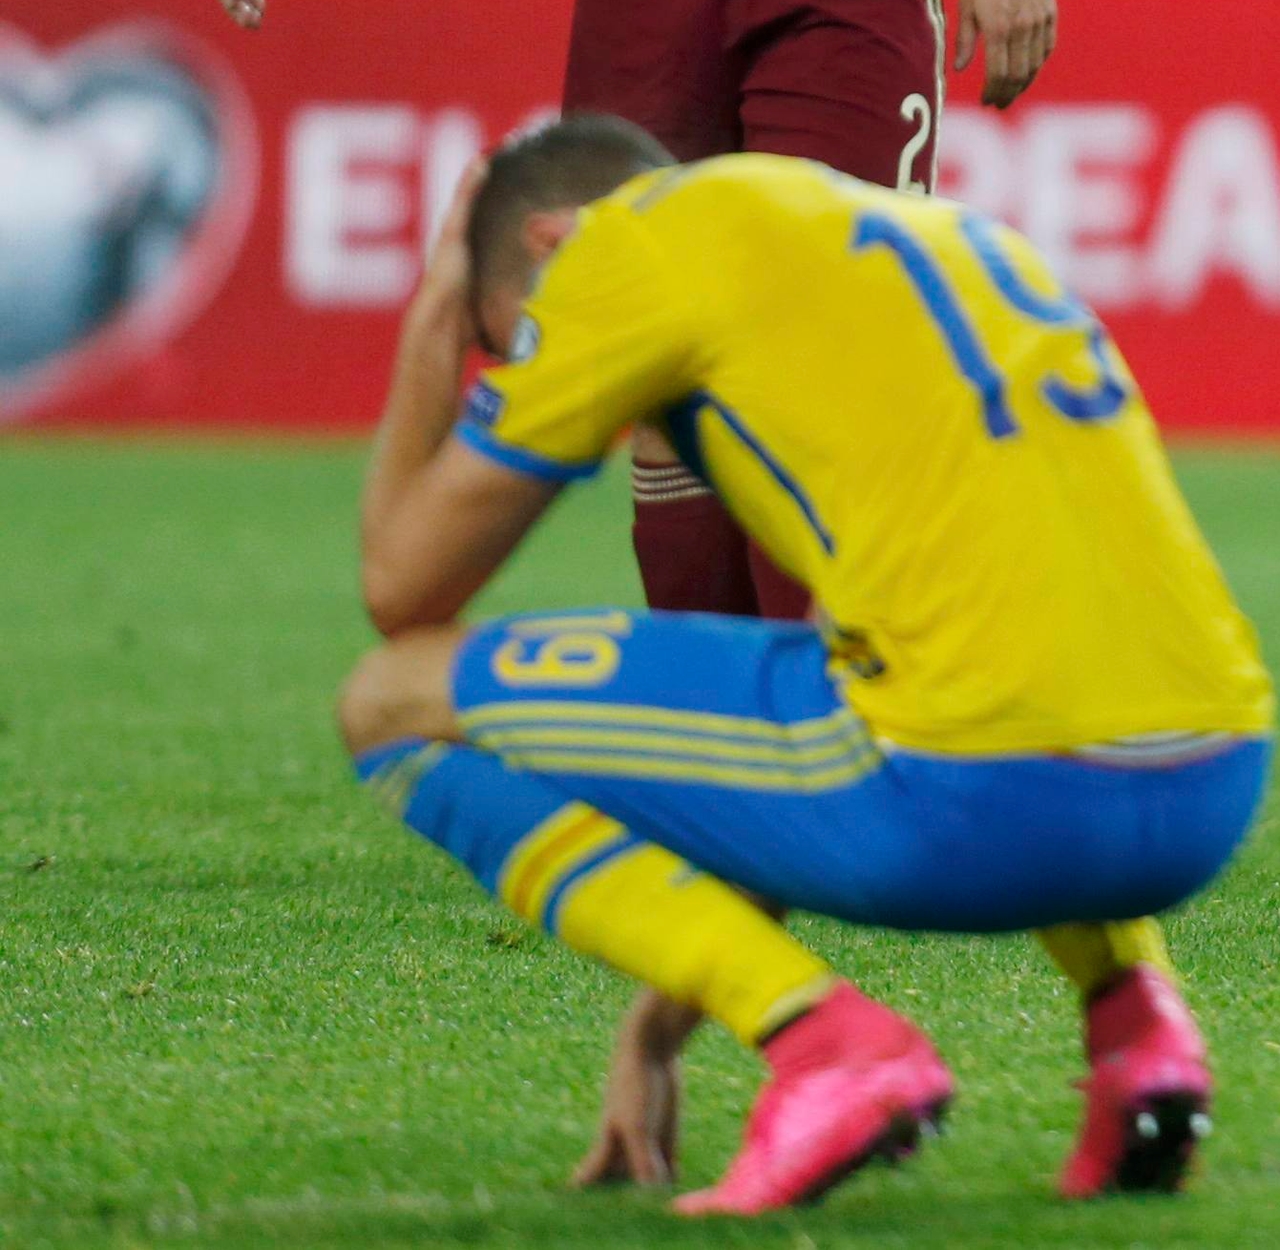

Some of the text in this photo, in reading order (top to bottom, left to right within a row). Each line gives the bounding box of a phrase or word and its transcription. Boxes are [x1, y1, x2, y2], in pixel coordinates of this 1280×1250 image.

[897, 93, 932, 194] 2
[853, 211, 1127, 441] 19
[492, 610, 634, 686] 19
